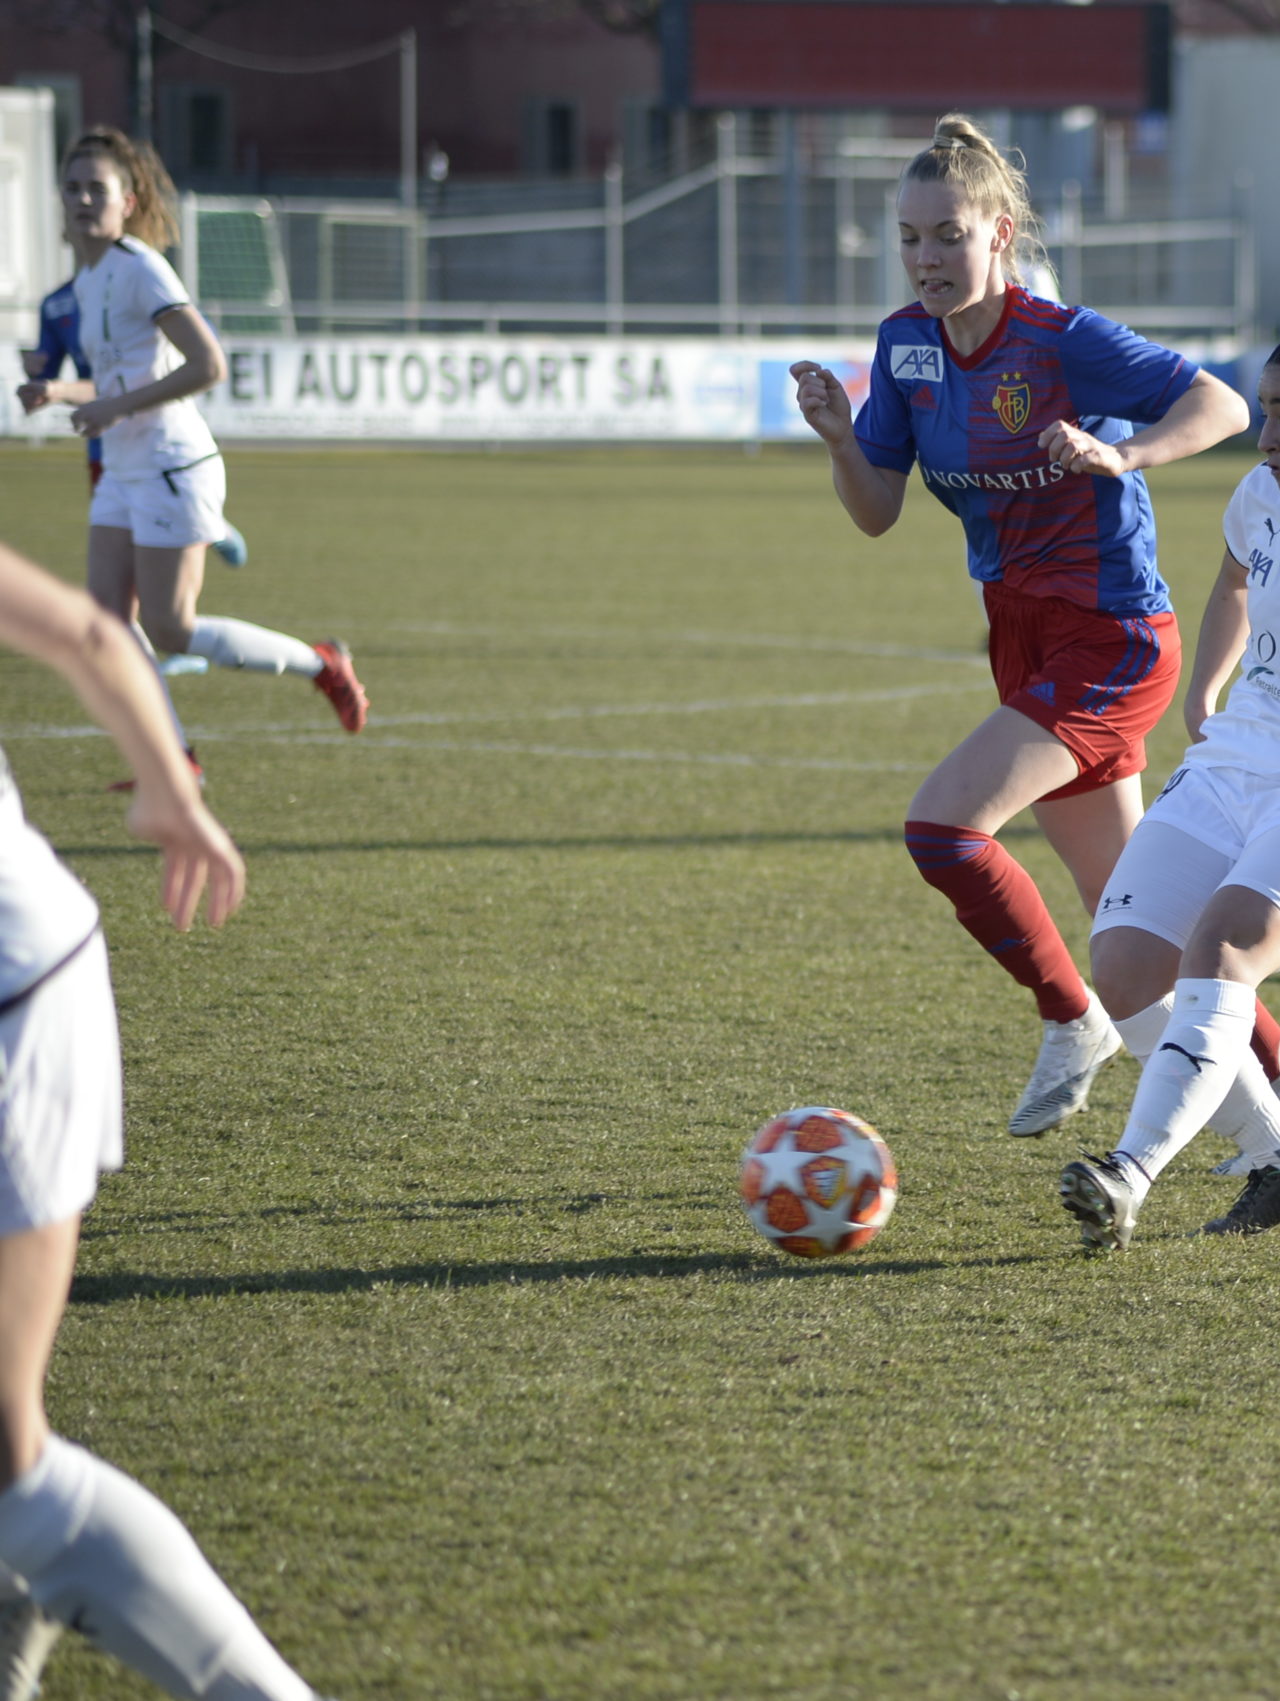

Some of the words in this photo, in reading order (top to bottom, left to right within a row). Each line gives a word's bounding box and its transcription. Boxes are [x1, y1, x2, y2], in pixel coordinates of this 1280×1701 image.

[205, 351, 272, 400] EI
[297, 351, 593, 401] AUTOSPORT
[613, 353, 673, 401] SA
[895, 349, 940, 378] AXA
[930, 461, 1065, 491] NOVARTIS
[1248, 548, 1274, 588] AXA
